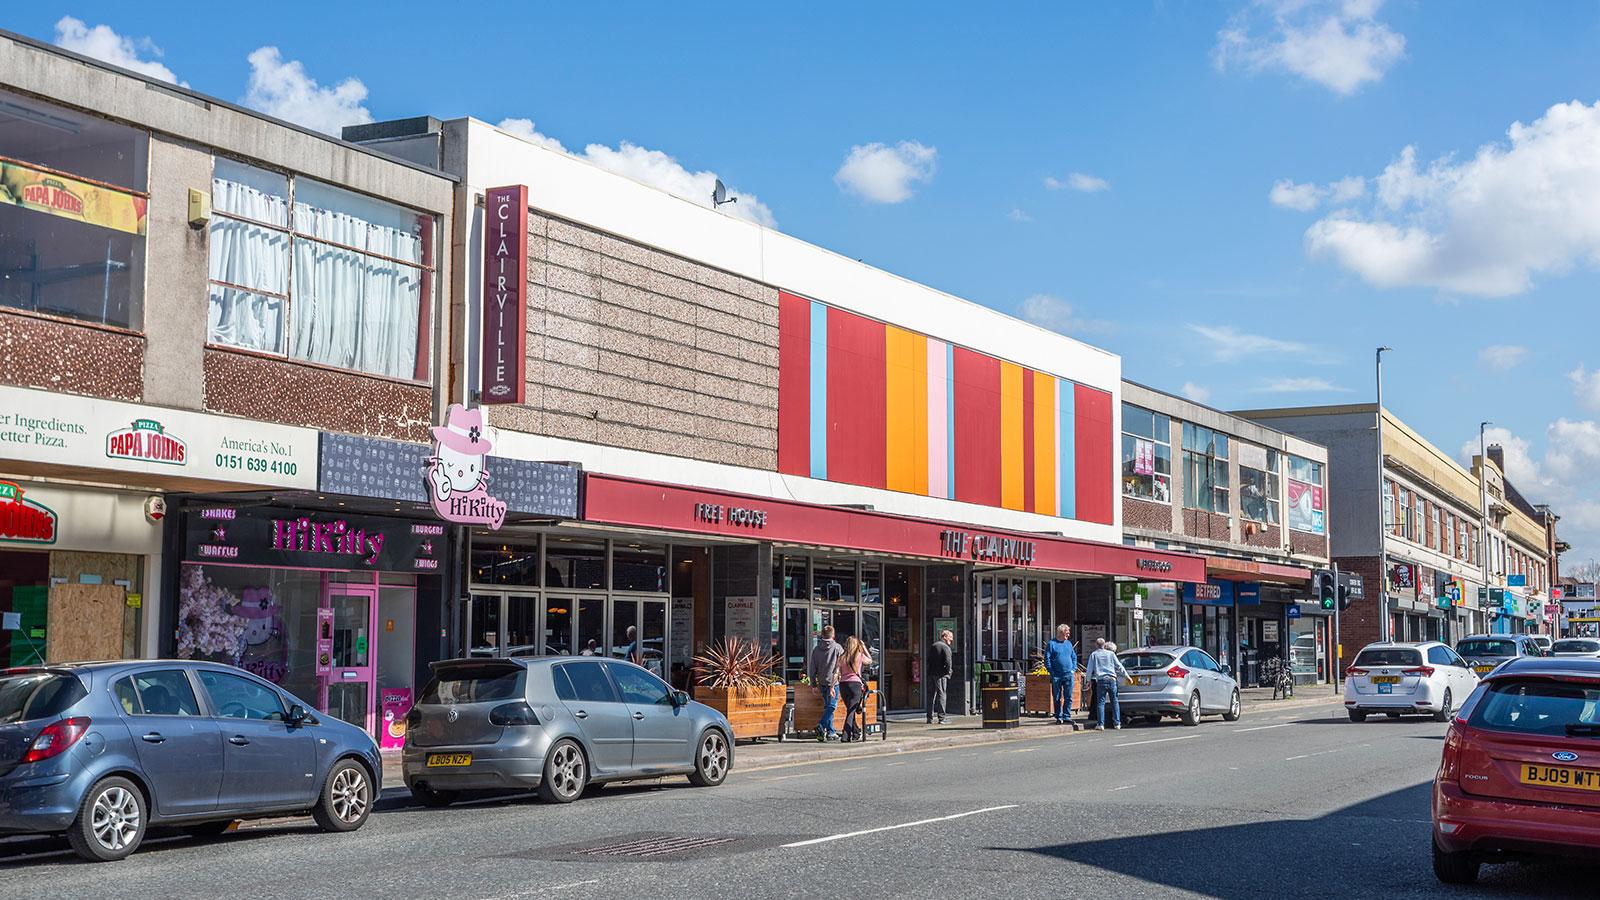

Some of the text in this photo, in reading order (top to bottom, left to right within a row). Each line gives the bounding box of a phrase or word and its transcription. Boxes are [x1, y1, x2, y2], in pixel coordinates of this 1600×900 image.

[24, 186, 49, 206] PAPA
[496, 195, 510, 203] THE
[496, 204, 509, 382] CLAIRVILLE
[15, 413, 87, 435] Ingredients.
[138, 421, 159, 430] PIZZA
[35, 431, 68, 448] Pizza.
[110, 432, 143, 457] PAPA
[220, 436, 292, 457] America's No.1
[215, 453, 297, 475] 0151 639 4100
[203, 508, 236, 519] SHAKES
[450, 495, 504, 523] HiKitty
[697, 502, 768, 526] FREE HOUSE
[414, 524, 443, 535] BURGERS
[203, 544, 239, 557] WAFFLES
[271, 518, 385, 565] HiKitty
[943, 529, 968, 554] THE
[1195, 583, 1221, 598] BETFRED
[1528, 766, 1569, 784] BJ09
